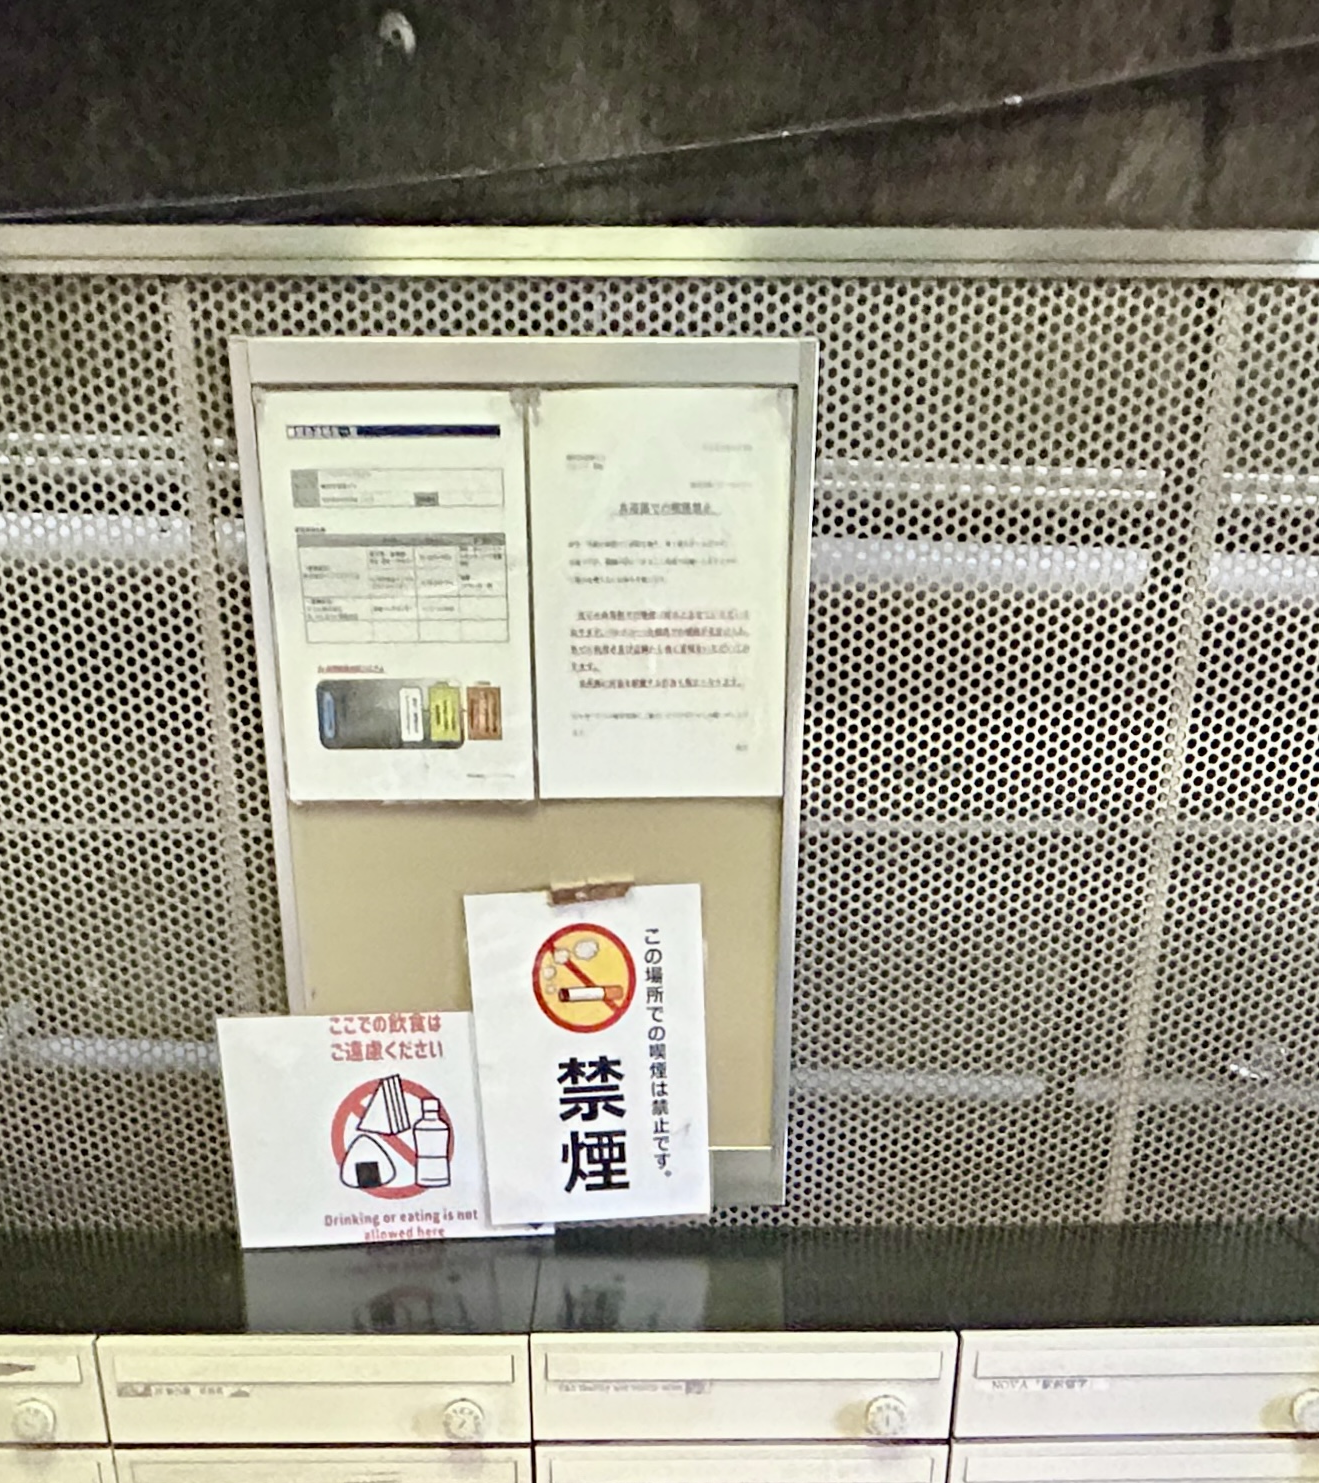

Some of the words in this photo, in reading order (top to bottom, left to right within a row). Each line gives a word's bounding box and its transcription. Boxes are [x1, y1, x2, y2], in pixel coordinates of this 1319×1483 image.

[329, 1013, 442, 1035] ここでの飲食は
[330, 1040, 443, 1062] ご遠慮ください
[643, 927, 673, 1177] この場所での喫煙は禁止です。
[558, 1056, 631, 1194] 禁煙
[324, 1213, 381, 1227] Drinking
[383, 1213, 396, 1223] or
[400, 1209, 441, 1223] eating
[443, 1208, 454, 1220] is
[457, 1208, 478, 1221] not
[364, 1226, 413, 1240] allowed
[417, 1225, 445, 1238] here
